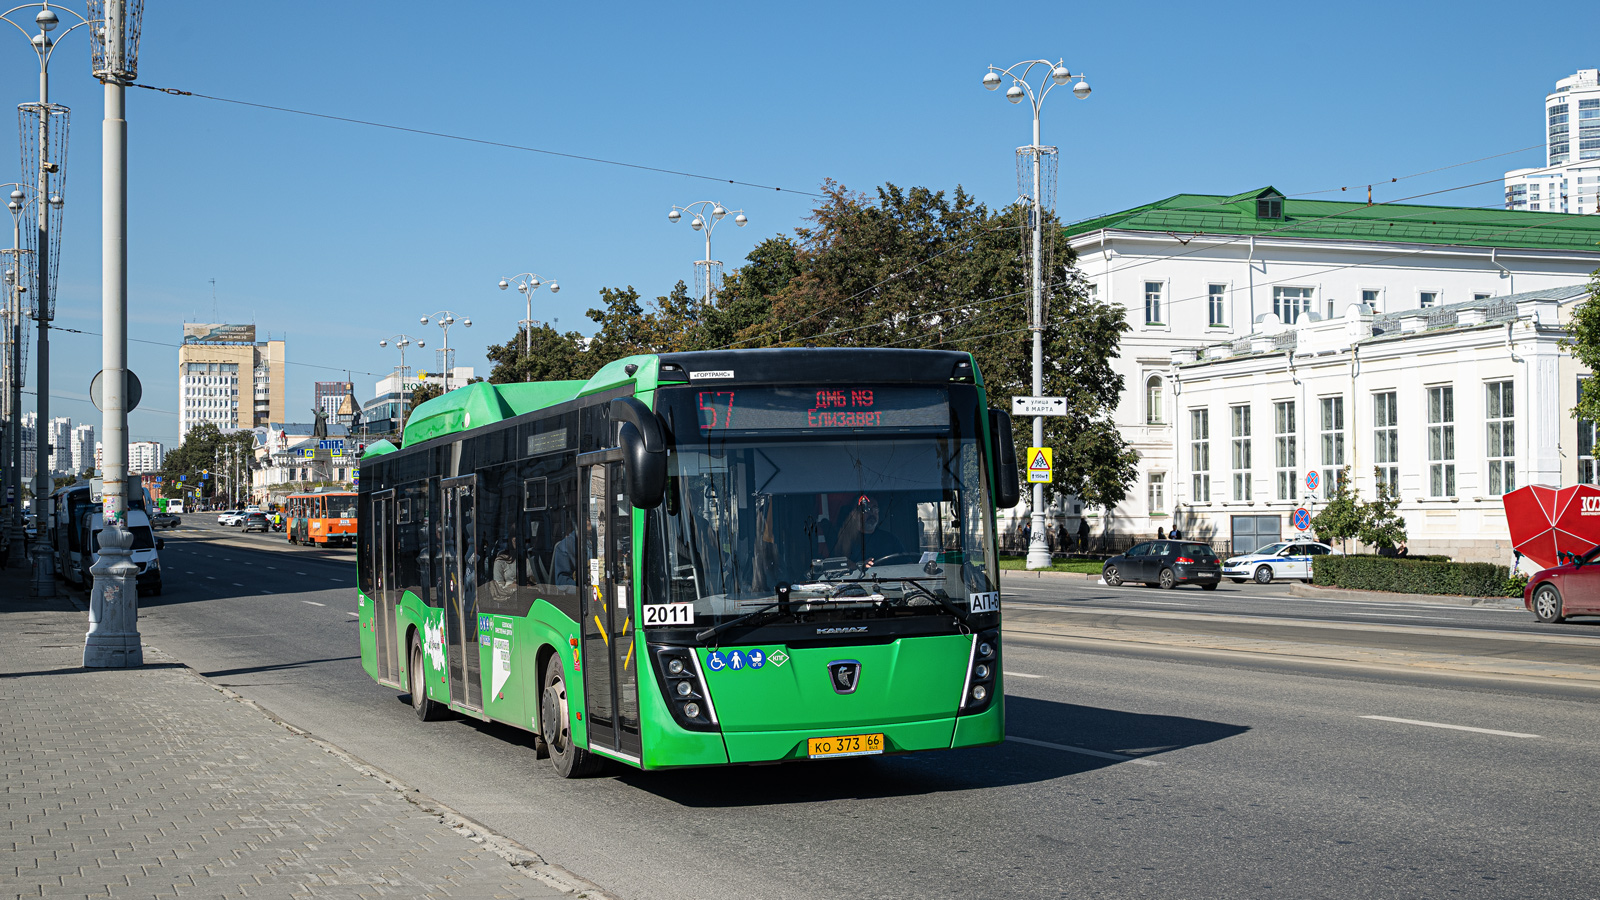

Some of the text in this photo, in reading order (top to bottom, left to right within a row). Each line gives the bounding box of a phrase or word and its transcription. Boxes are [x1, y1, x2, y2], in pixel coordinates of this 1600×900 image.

[815, 390, 847, 409] ДМБ
[699, 391, 735, 429] 57
[807, 408, 882, 428] Елизавет
[972, 594, 999, 611] АП-6
[647, 605, 688, 623] 2011
[816, 626, 869, 635] KAMAZ
[836, 738, 860, 751] 373
[867, 735, 879, 745] 66
